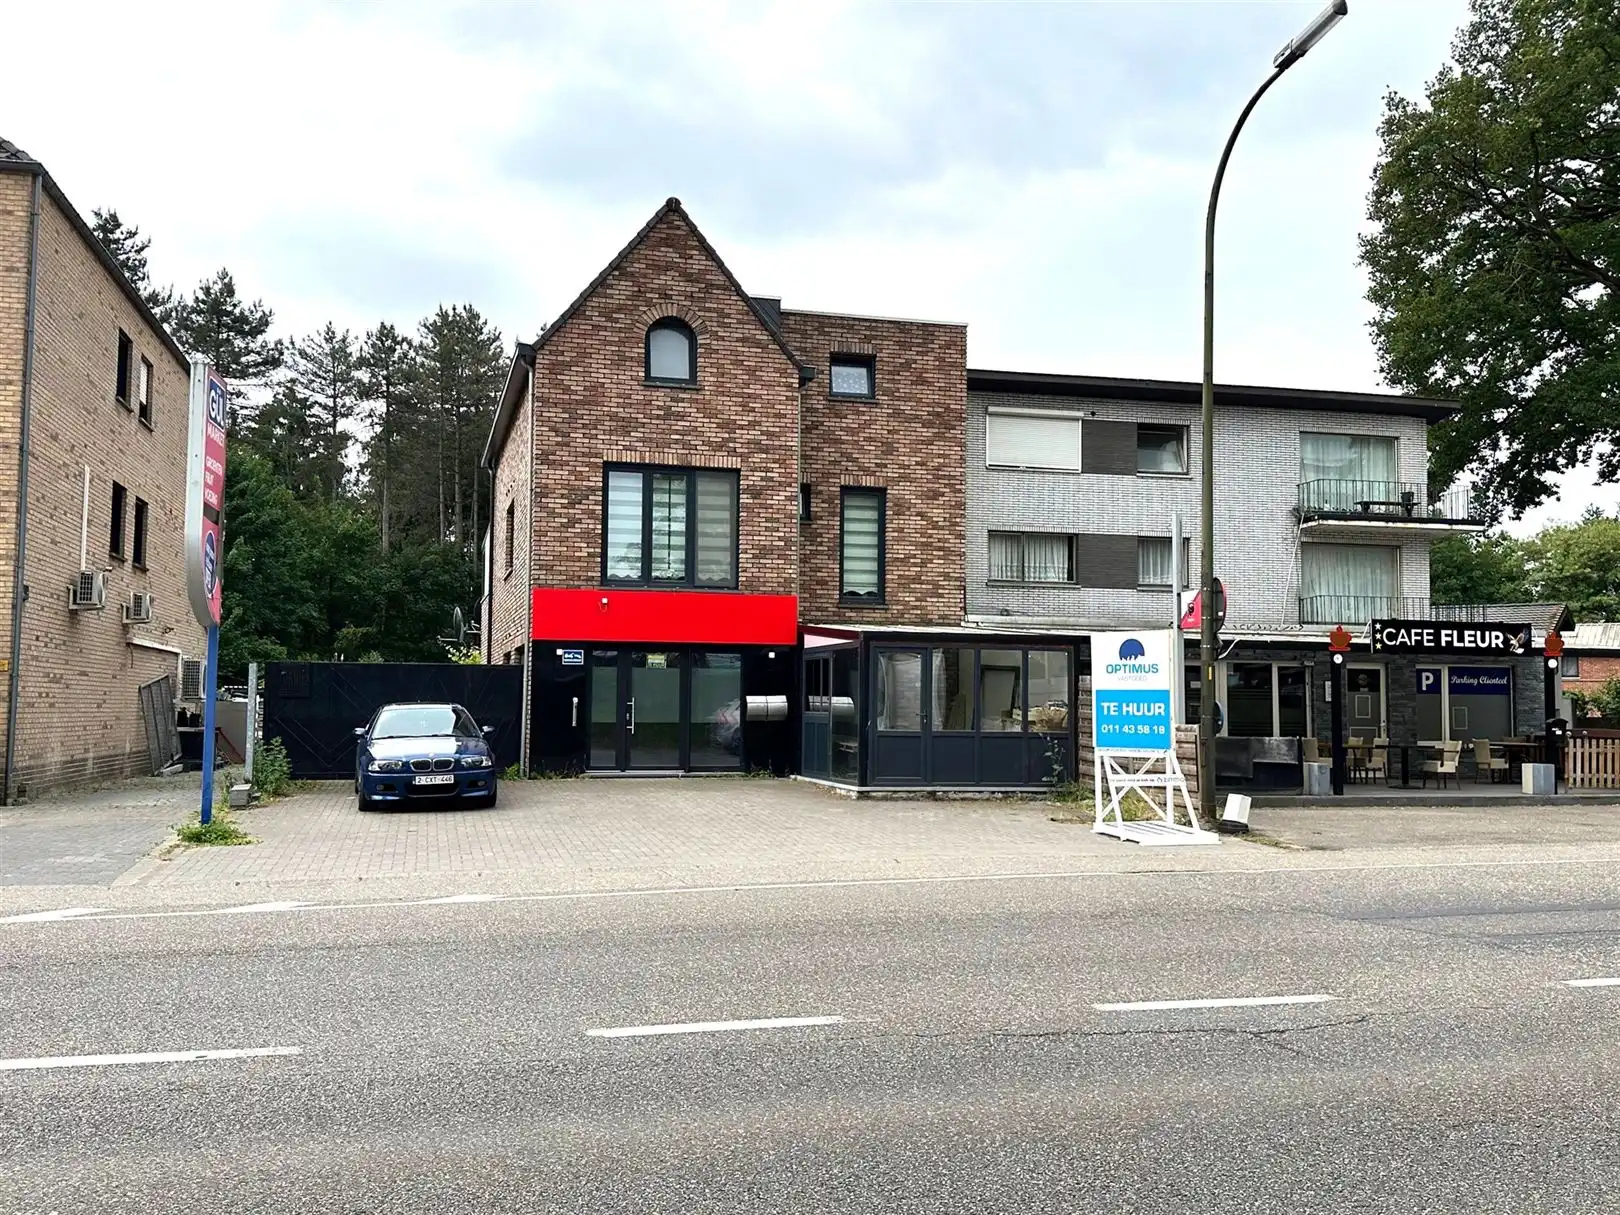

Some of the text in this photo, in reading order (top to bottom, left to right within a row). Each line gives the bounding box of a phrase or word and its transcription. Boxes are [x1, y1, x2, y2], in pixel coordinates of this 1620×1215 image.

[1382, 628, 1504, 648] CAFE FLEUR
[1106, 663, 1159, 674] OPTIMUS
[1421, 671, 1434, 691] P
[1450, 675, 1478, 686] Parking
[1101, 702, 1165, 717] TE HUUR
[1101, 724, 1120, 733] 011
[1122, 725, 1135, 734] 43
